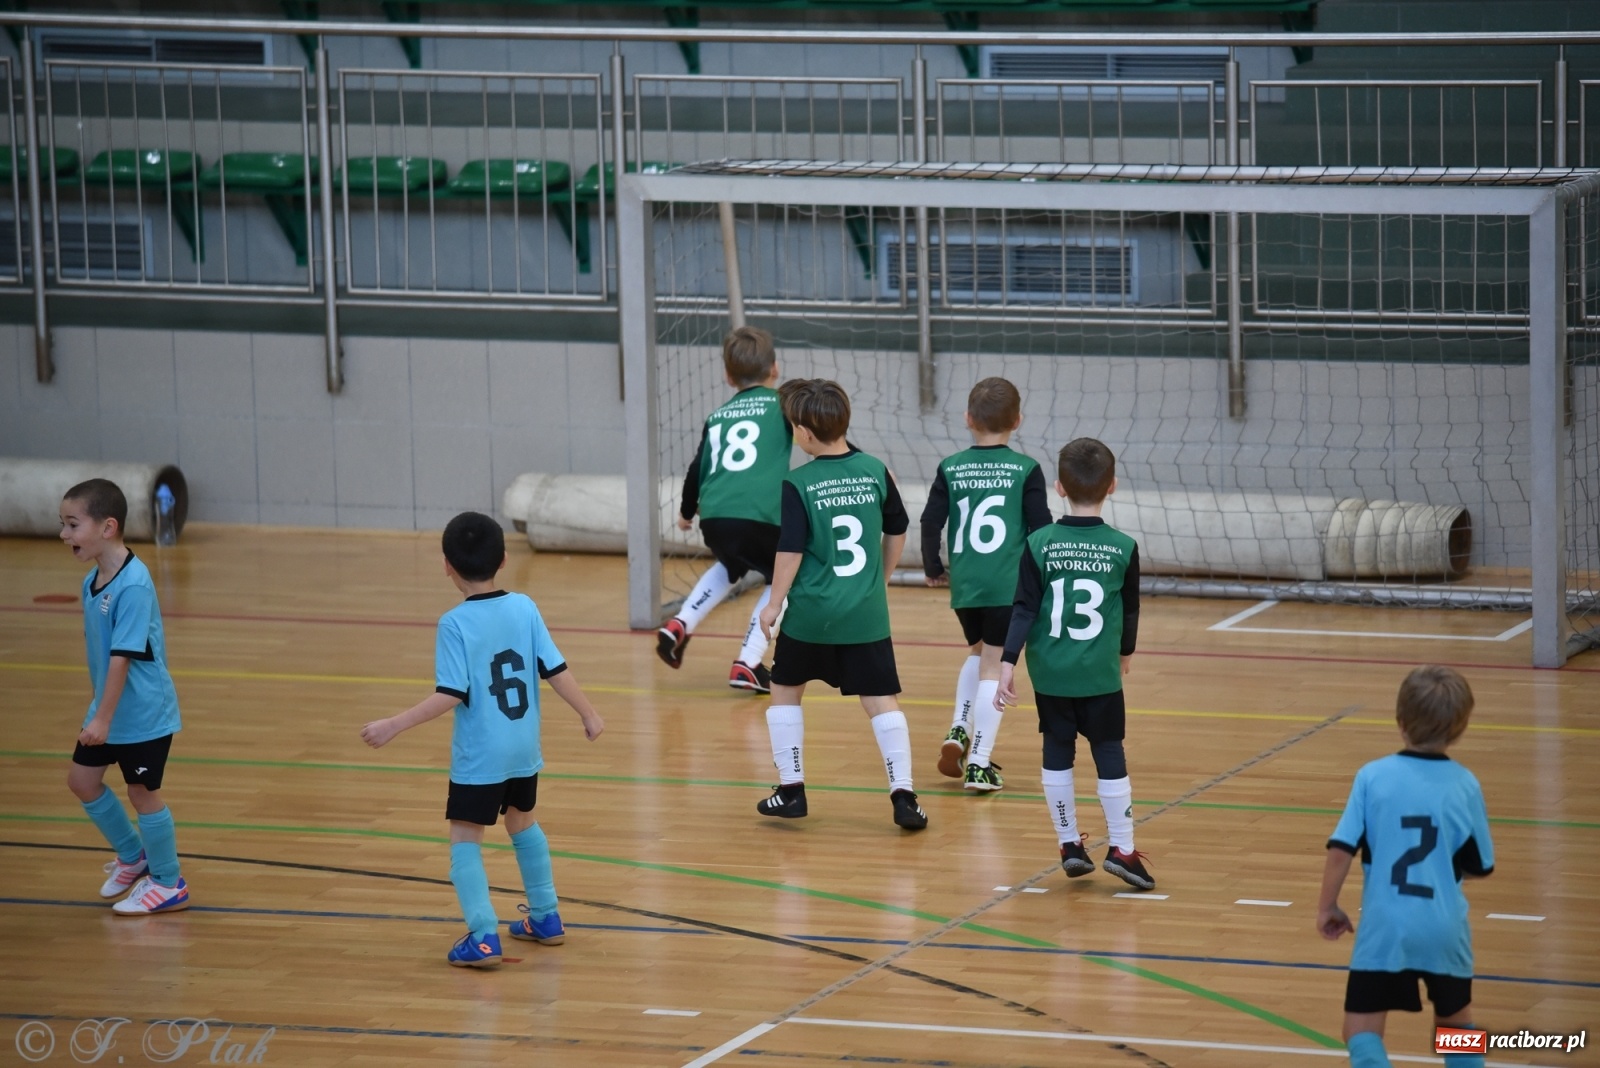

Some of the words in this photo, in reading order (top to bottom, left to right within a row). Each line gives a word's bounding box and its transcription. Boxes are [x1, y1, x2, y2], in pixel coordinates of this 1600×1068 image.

[708, 420, 760, 475] 18
[945, 463, 982, 472] AKADEMIA
[983, 463, 1024, 471] PIŁKARSKA
[955, 470, 991, 478] MŁODEGO
[806, 479, 842, 492] AKADEMIA
[951, 476, 1015, 491] TWORKÓW
[817, 486, 851, 497] MŁODEGO
[814, 492, 876, 510] TWORKÓW
[953, 495, 1007, 554] 16
[831, 514, 867, 577] 3
[1079, 542, 1123, 555] PIŁKARSKA
[1048, 550, 1087, 559] MŁODEGO
[1045, 559, 1114, 574] TWORKÓW
[1049, 577, 1104, 641] 13
[488, 648, 529, 721] 6
[1391, 815, 1439, 899] 2
